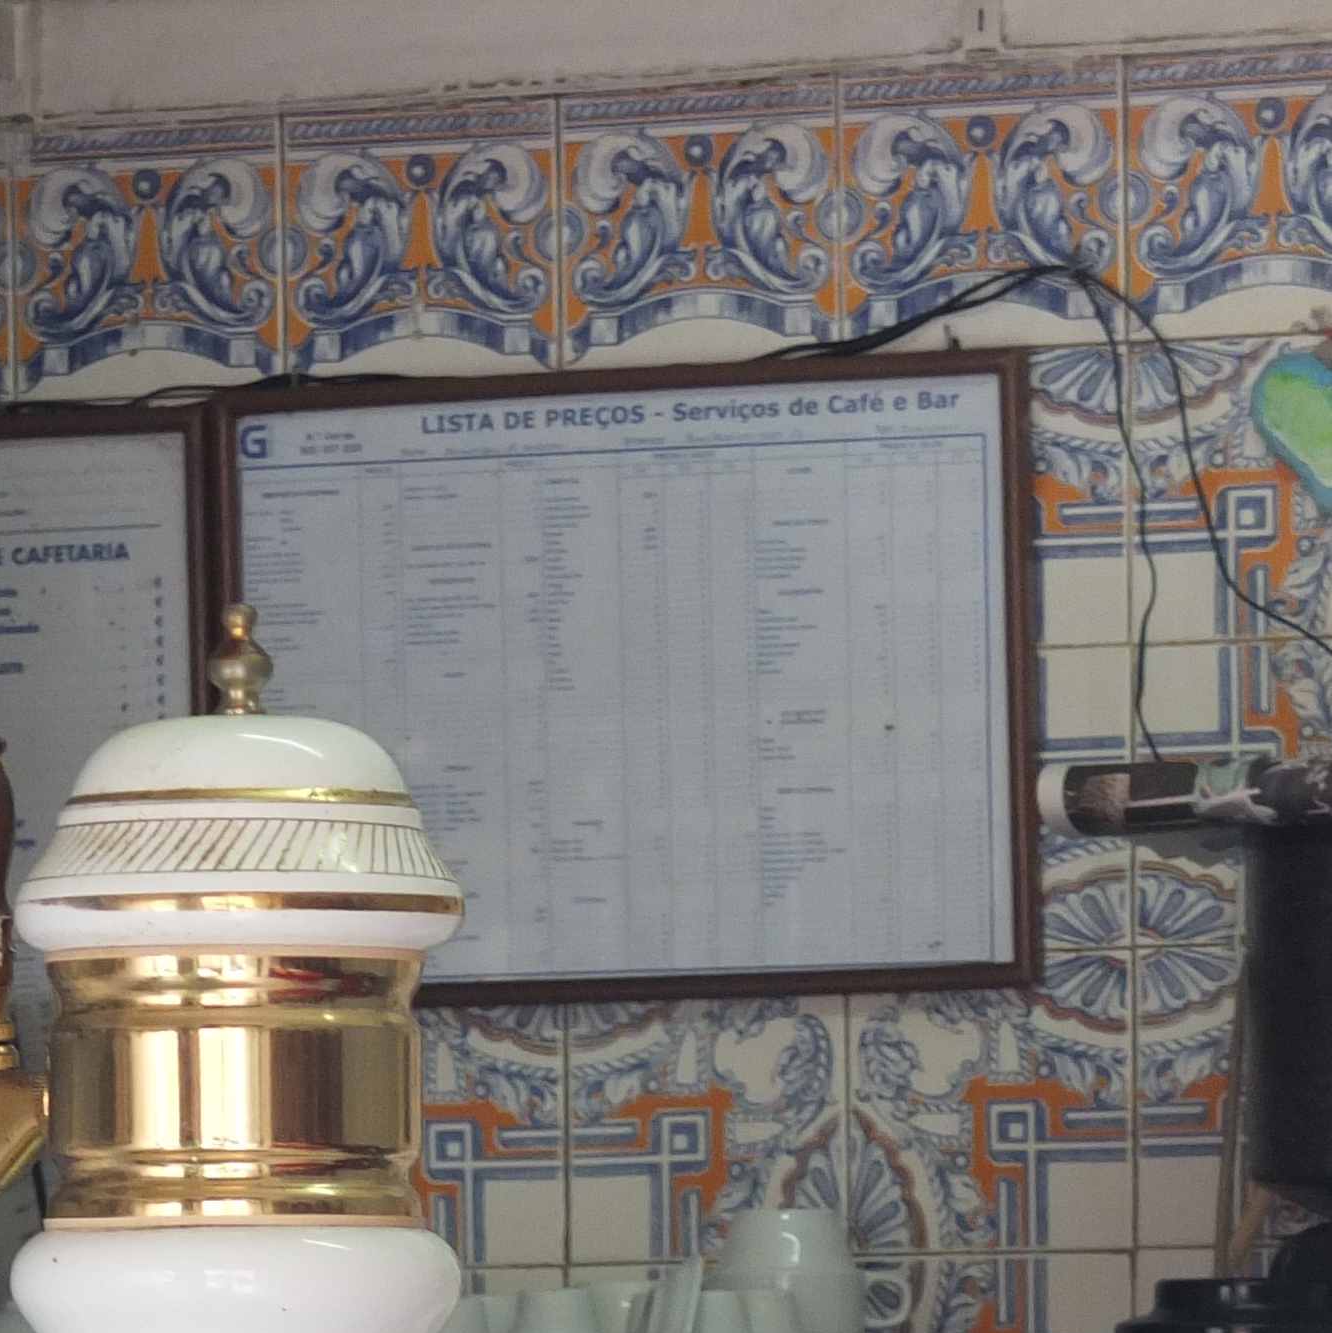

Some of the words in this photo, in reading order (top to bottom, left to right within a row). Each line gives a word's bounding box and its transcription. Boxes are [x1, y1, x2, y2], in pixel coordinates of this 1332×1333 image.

[422, 412, 495, 435] LISTA
[503, 410, 536, 430] DE
[544, 404, 645, 431] PREÇOS
[672, 399, 780, 423] Serviços
[789, 397, 819, 417] de
[827, 390, 885, 415] Café
[893, 396, 908, 412] e
[917, 391, 961, 411] Bar
[240, 424, 268, 459] G
[11, 542, 131, 565] CAFETARIA
